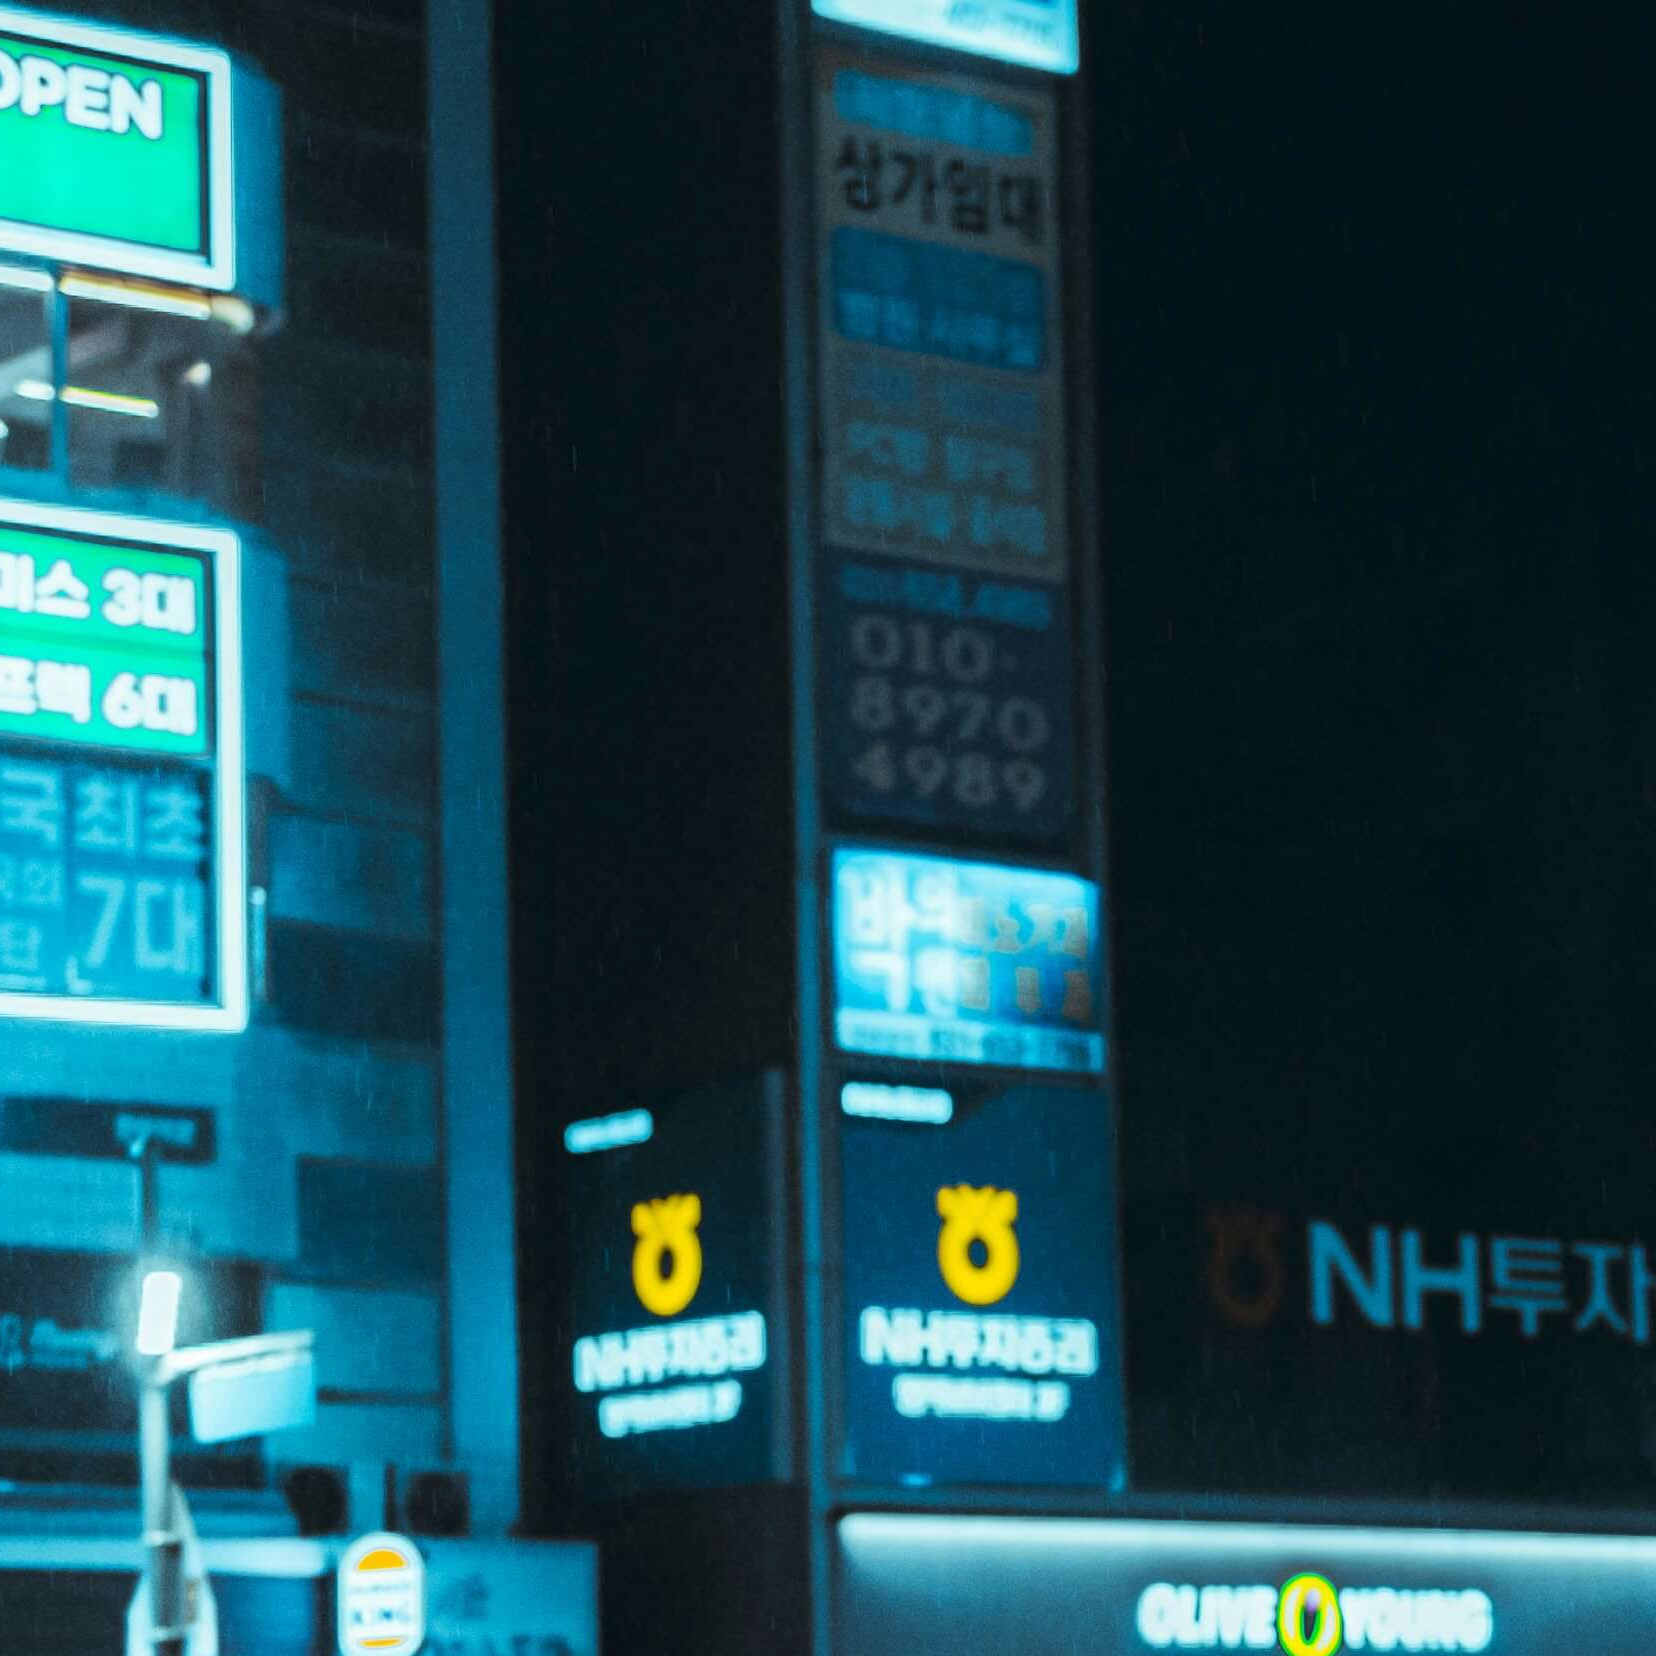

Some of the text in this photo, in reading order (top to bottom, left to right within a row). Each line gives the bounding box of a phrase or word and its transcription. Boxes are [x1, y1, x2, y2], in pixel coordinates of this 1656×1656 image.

[101, 566, 198, 636] 3대
[101, 671, 199, 737] 6대
[849, 738, 1049, 815] 4989
[1137, 1582, 1494, 1653] OLIVE YOUNG
